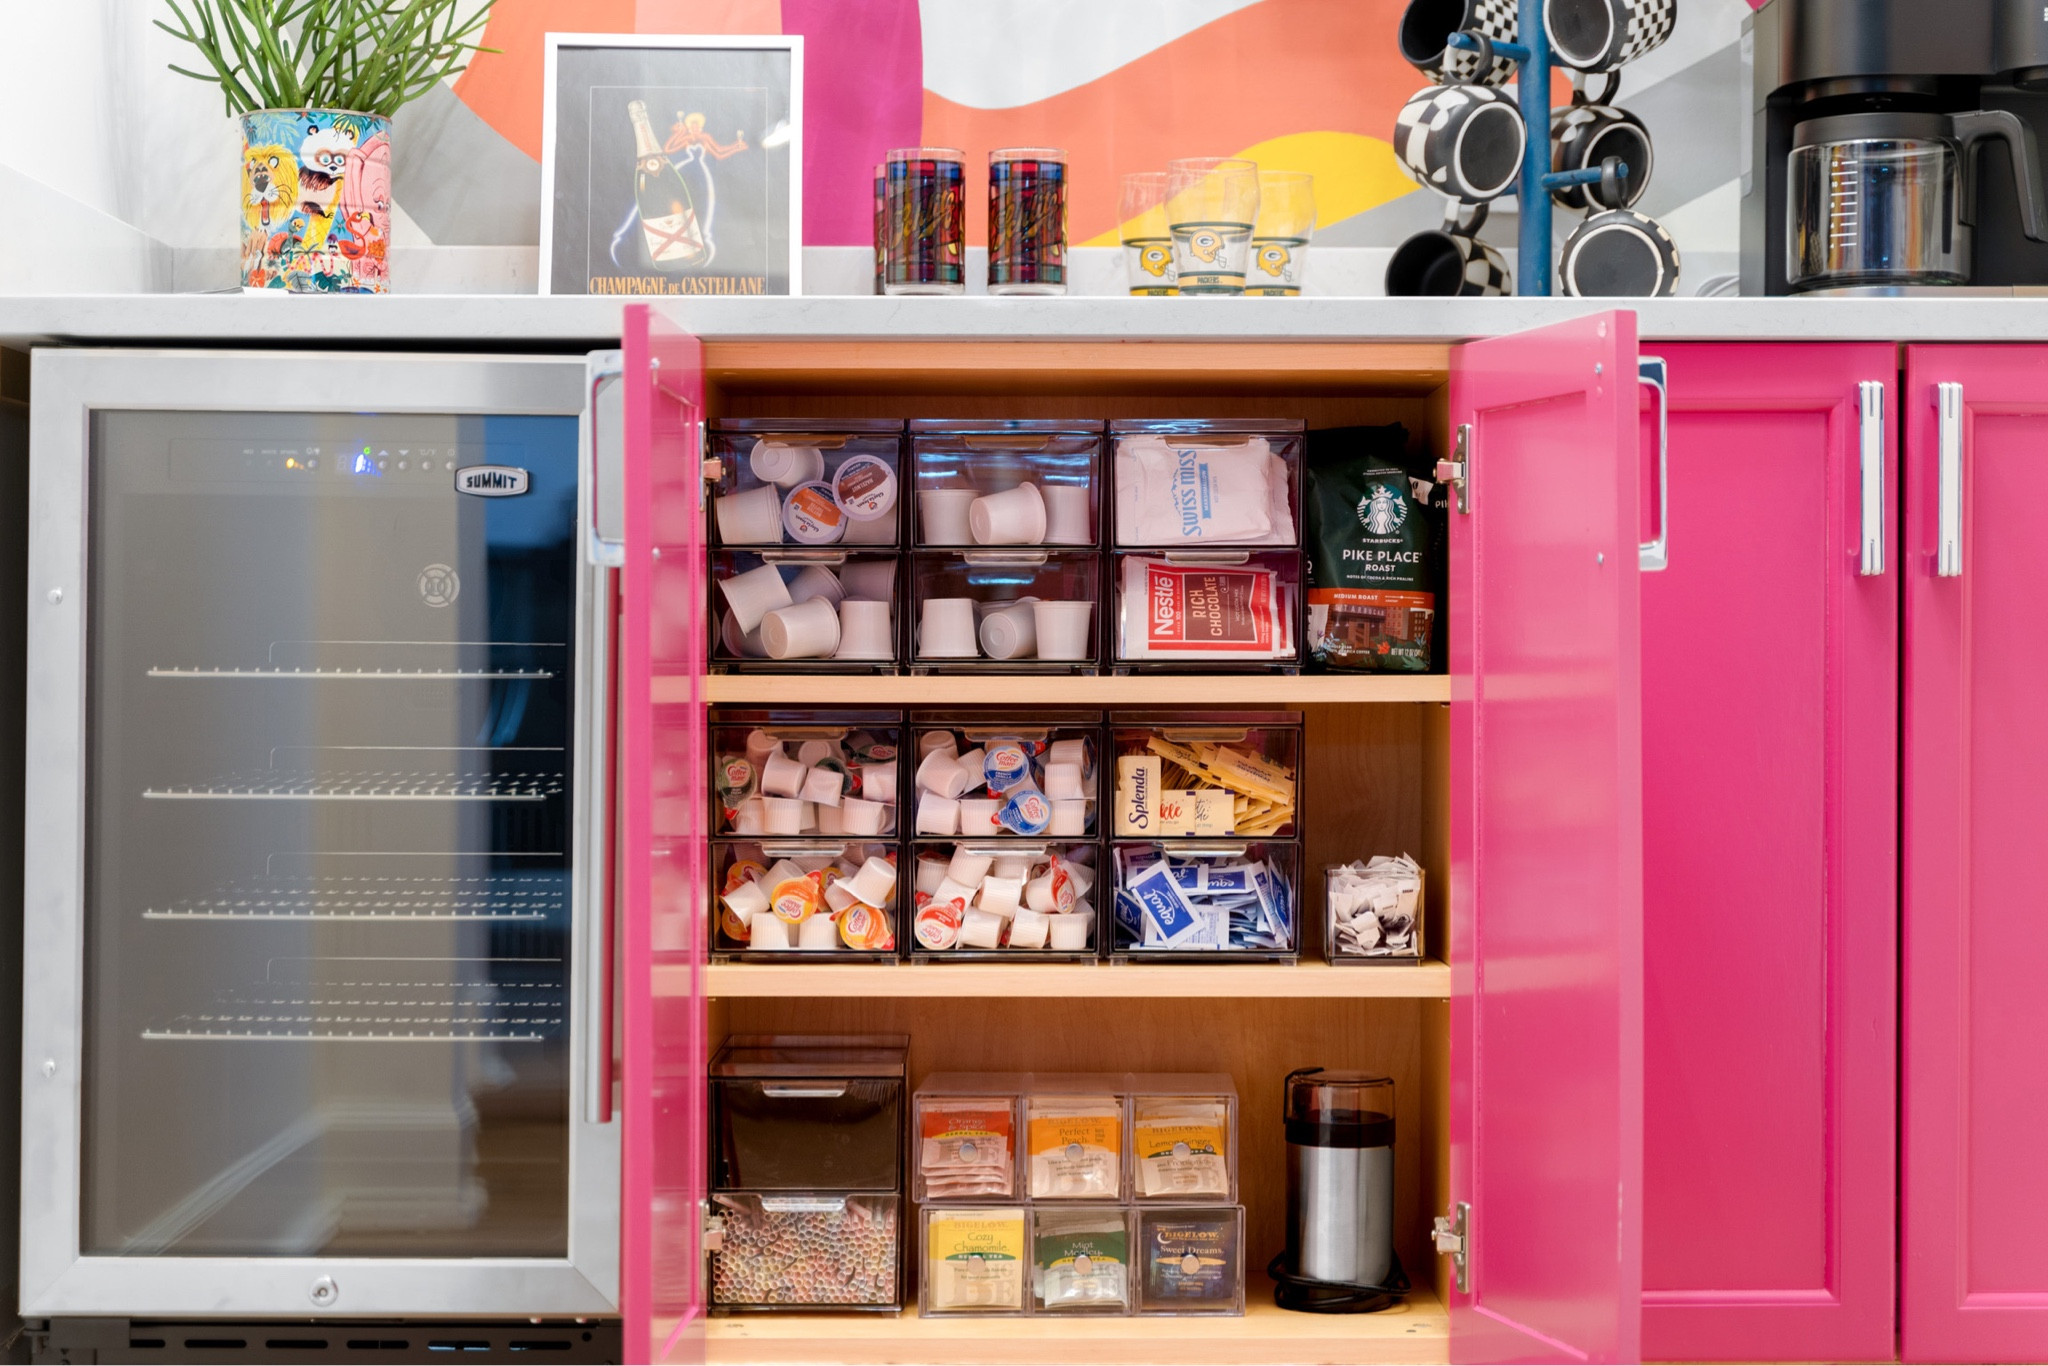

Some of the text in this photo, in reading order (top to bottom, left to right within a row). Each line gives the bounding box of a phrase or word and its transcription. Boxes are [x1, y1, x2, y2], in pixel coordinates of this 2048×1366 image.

[589, 276, 765, 296] CHAMPAGNE DE CASTELLANE
[466, 472, 517, 489] SUMMIT
[1183, 488, 1202, 536] SWISS
[1342, 550, 1420, 563] PIKE PLACE
[1154, 576, 1174, 635] Nestlé
[1189, 590, 1206, 618] RICH
[1204, 576, 1222, 636] CHOCOLATE
[996, 752, 1018, 762] Coffee
[728, 765, 747, 776] Coffee
[1129, 768, 1149, 829] Splenda
[1208, 879, 1235, 887] equ
[1143, 888, 1174, 925] equal
[1060, 1128, 1089, 1136] Perfect
[1062, 1136, 1087, 1145] Peach
[968, 1232, 993, 1244] Cozy
[1160, 1245, 1185, 1253] Sweet
